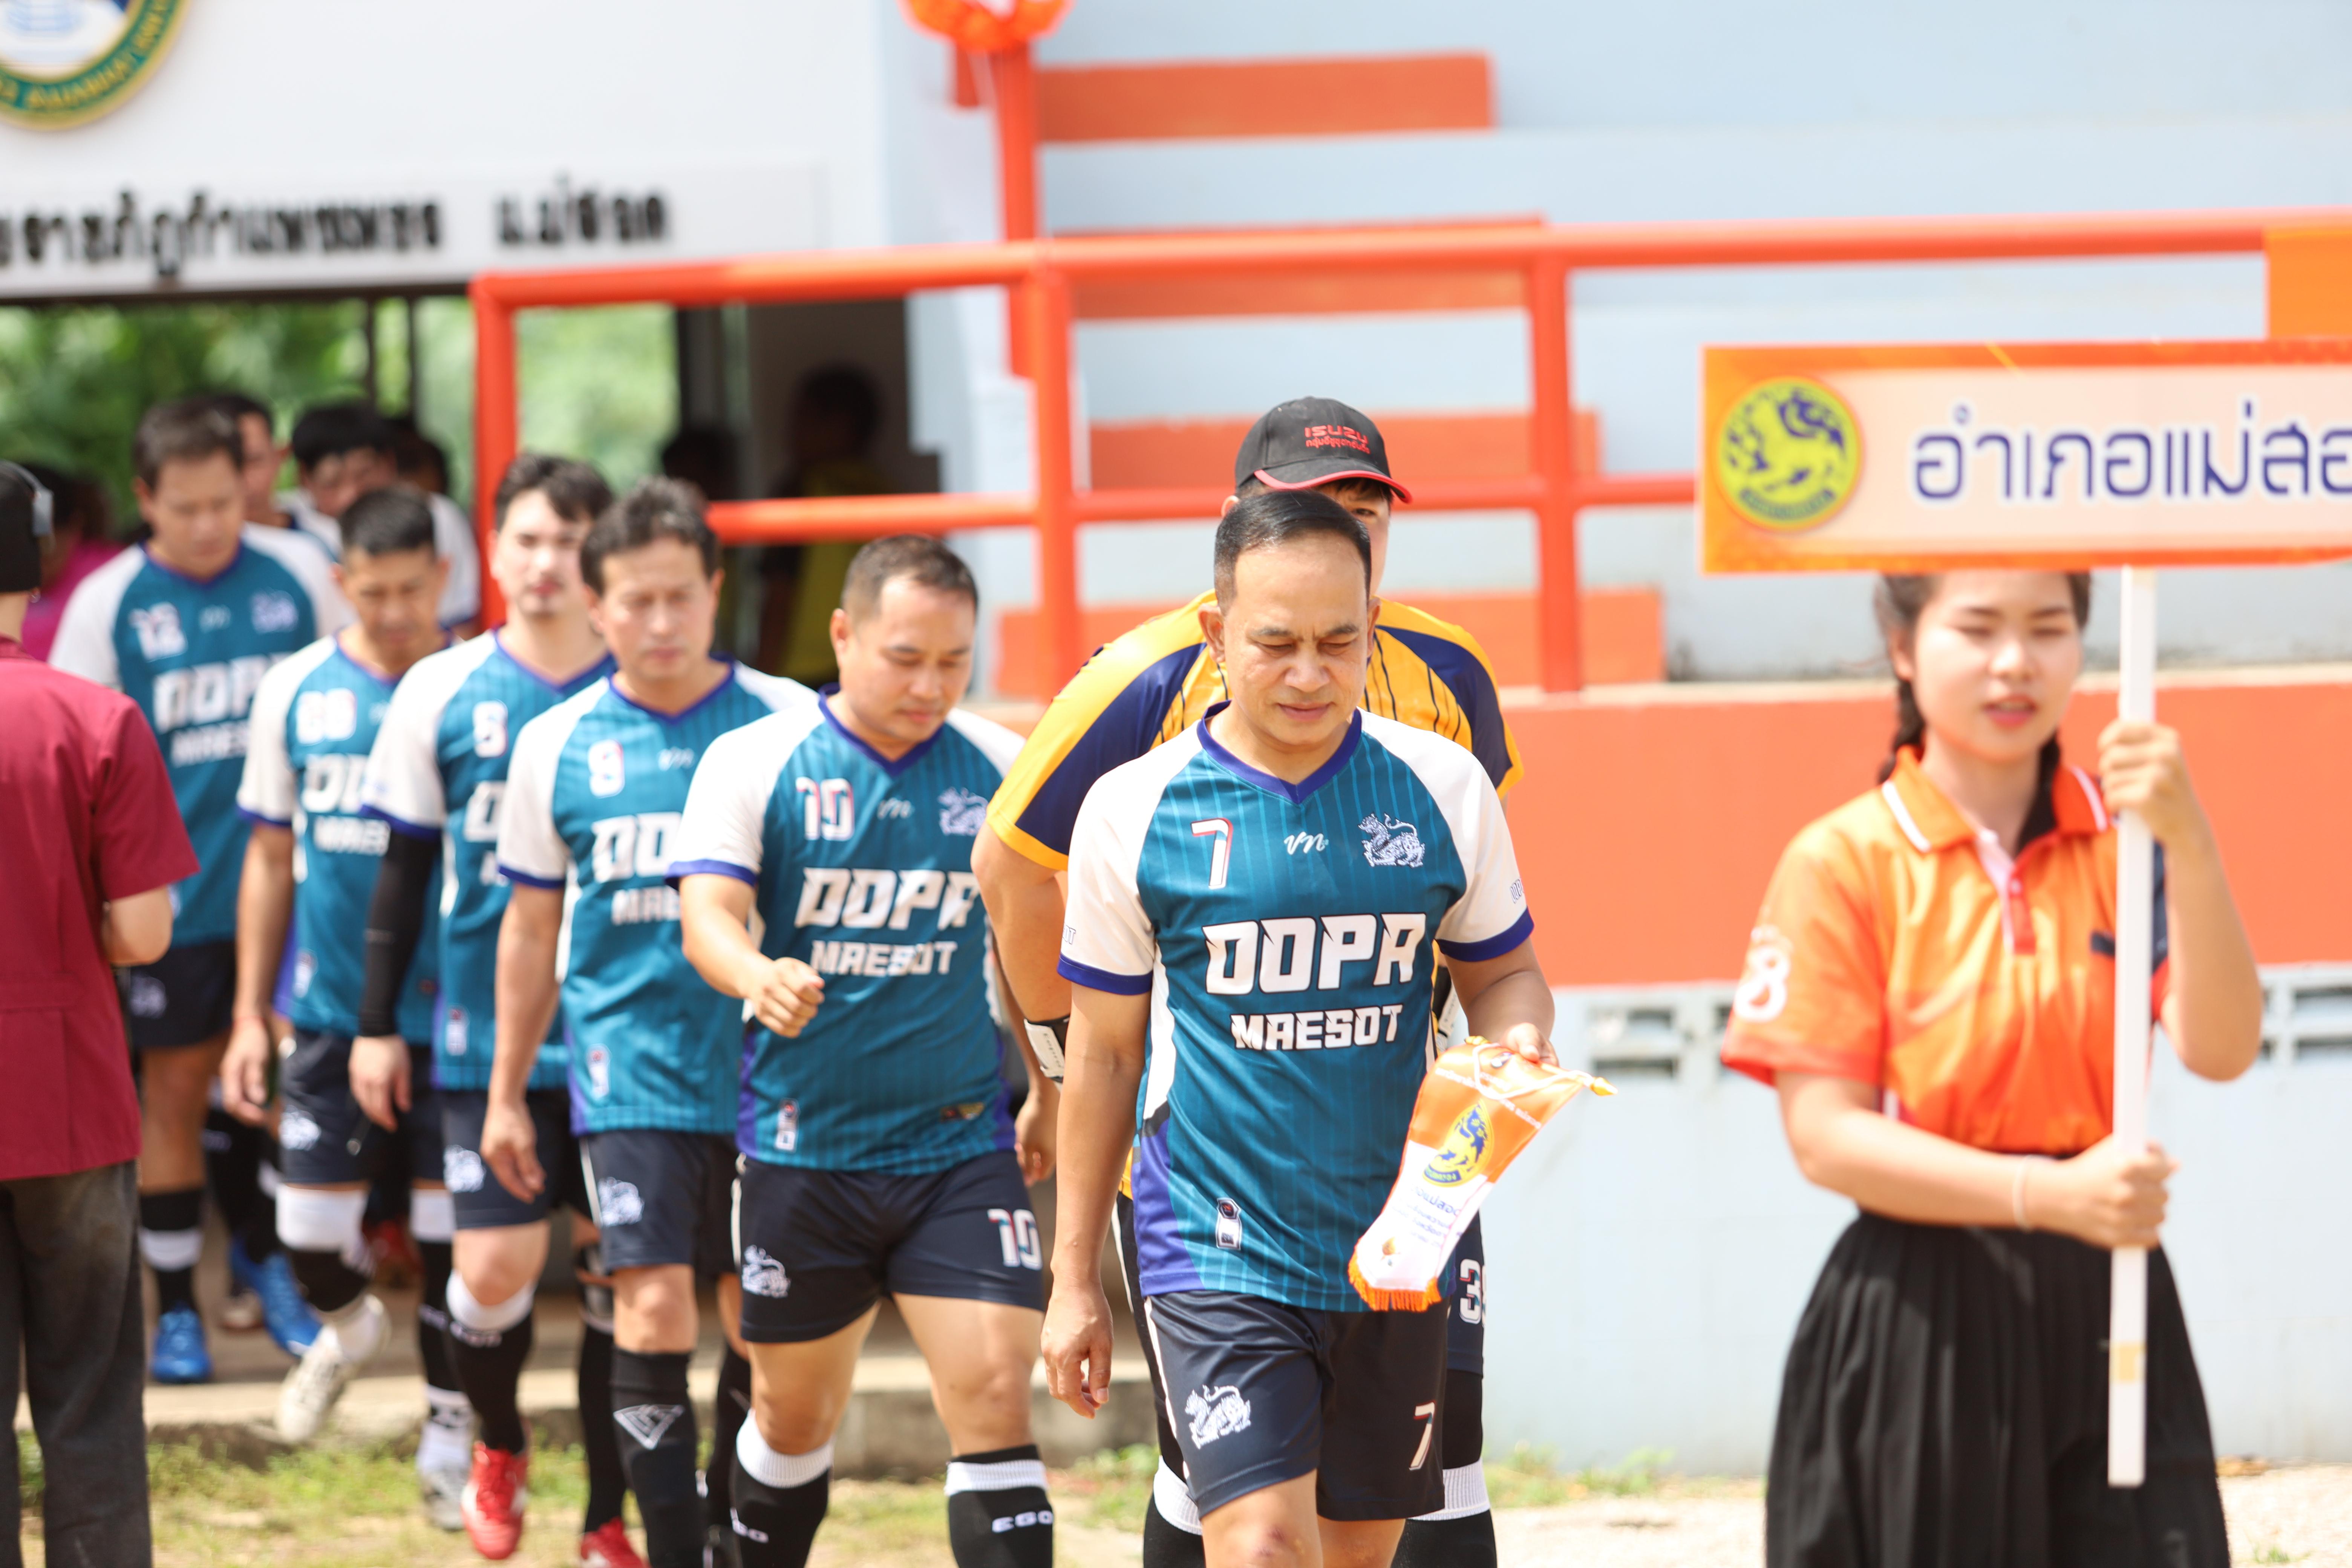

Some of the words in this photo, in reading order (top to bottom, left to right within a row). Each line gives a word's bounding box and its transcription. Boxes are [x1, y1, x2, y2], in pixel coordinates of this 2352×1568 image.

[1305, 424, 1369, 444] ISUZU
[1190, 817, 1233, 890] 7
[794, 867, 981, 930] DOPA
[810, 940, 957, 977] MAESOT
[1202, 912, 1426, 995] DOPA
[1230, 1004, 1403, 1051] MAESOT
[1459, 1257, 1487, 1325] 3
[1409, 1400, 1435, 1471] 7
[991, 1510, 1054, 1534] EGO
